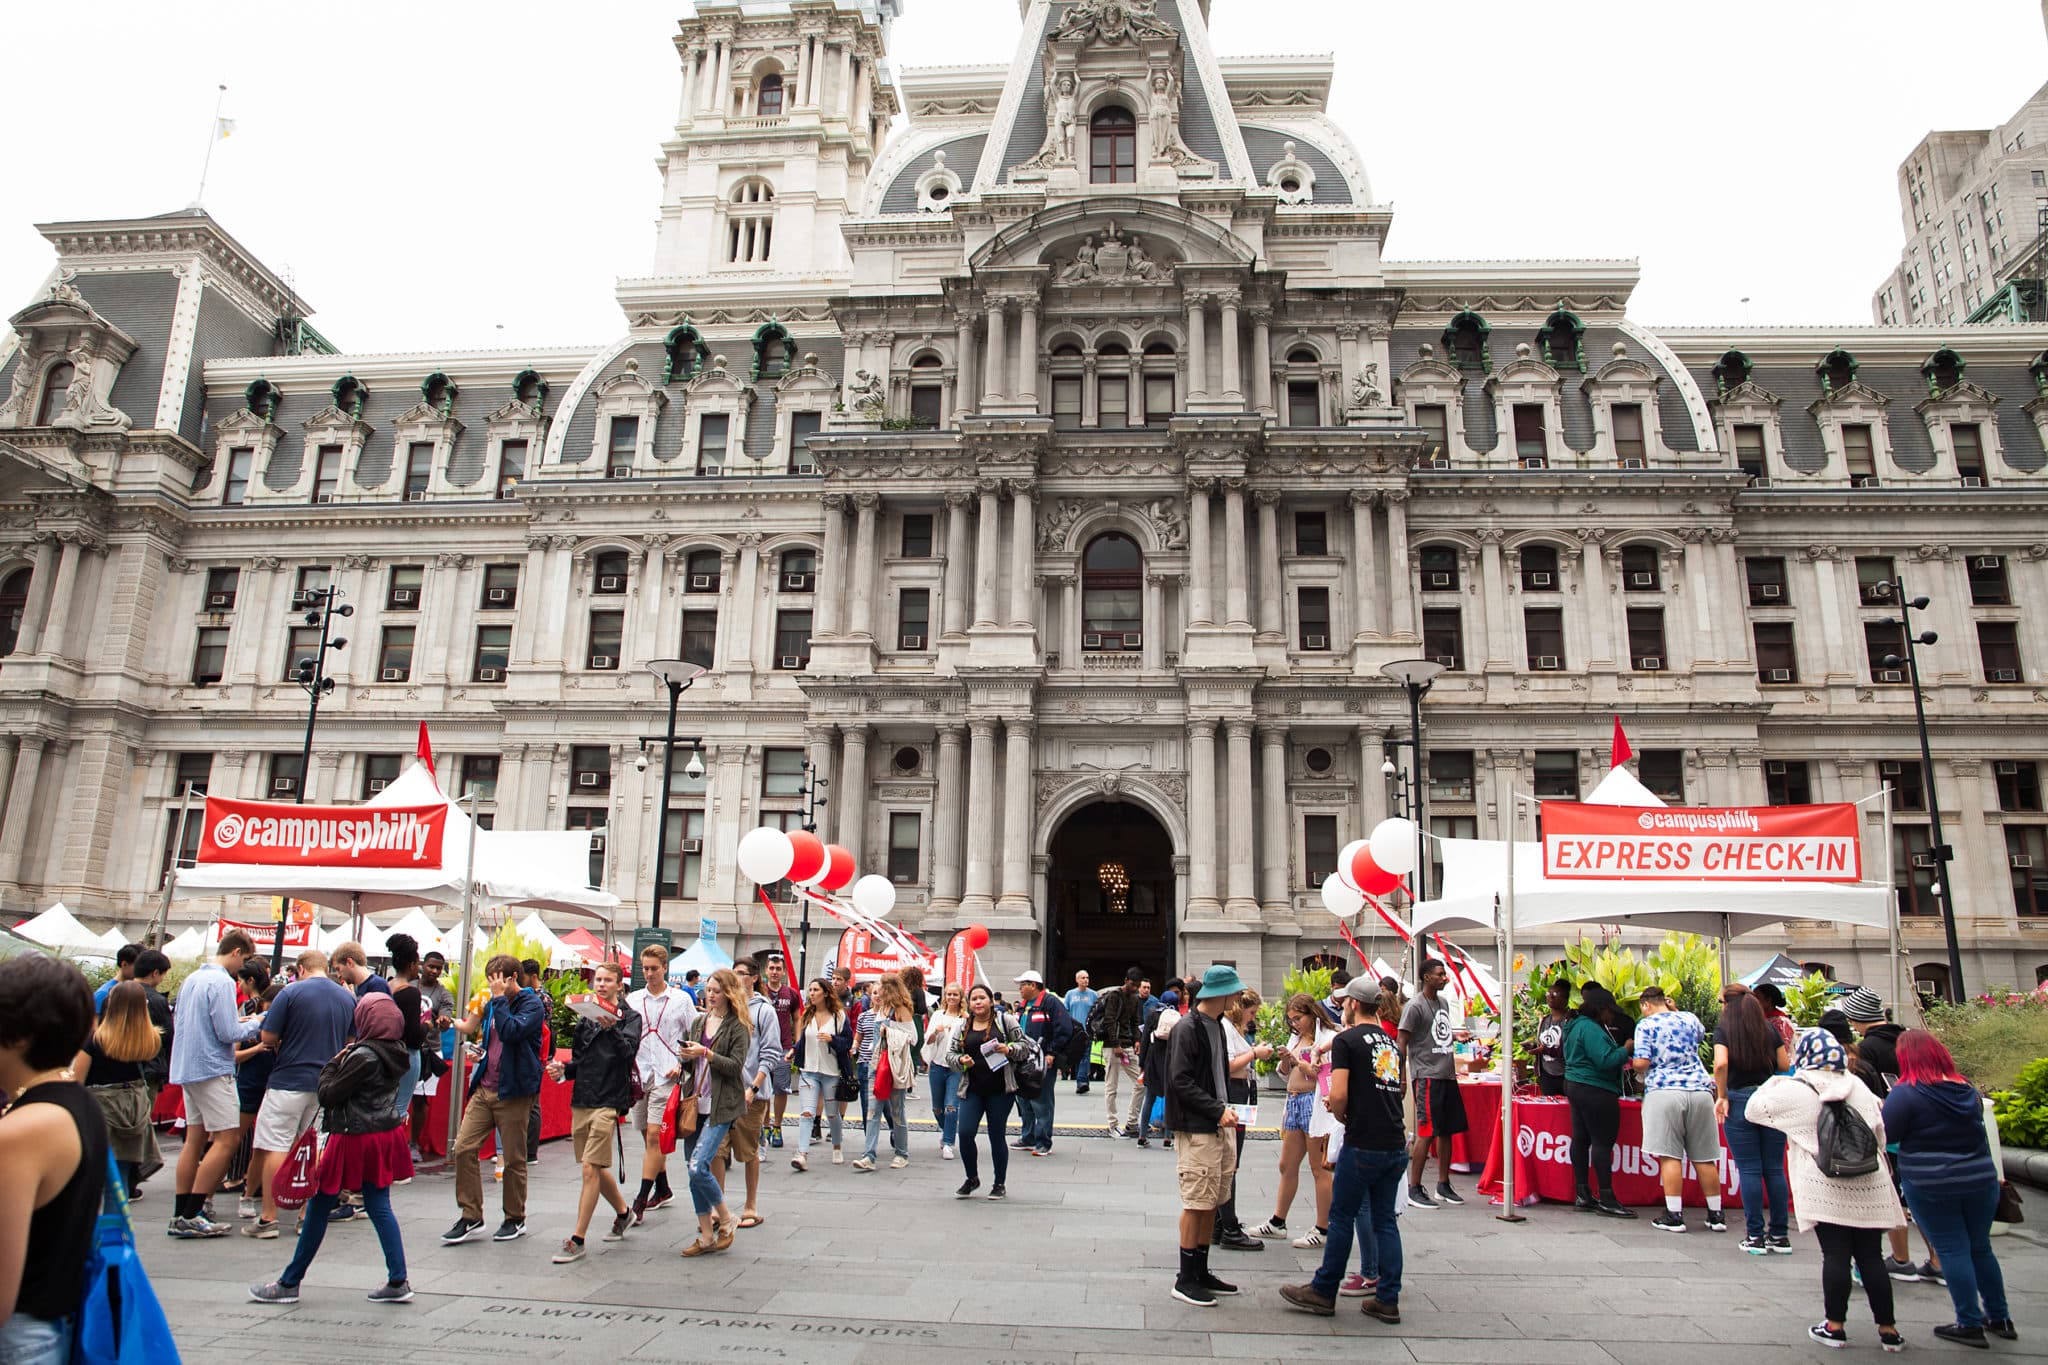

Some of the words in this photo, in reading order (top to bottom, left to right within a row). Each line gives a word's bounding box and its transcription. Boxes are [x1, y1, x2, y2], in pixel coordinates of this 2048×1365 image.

[244, 813, 430, 860] campusphilly
[1655, 811, 1758, 832] campusphilly
[1556, 840, 1692, 870] EXPRESS
[1702, 842, 1847, 872] CHECK-IN
[483, 1305, 665, 1324] DILWORTH
[679, 1317, 775, 1330] PARK
[790, 1323, 938, 1338] DONORS
